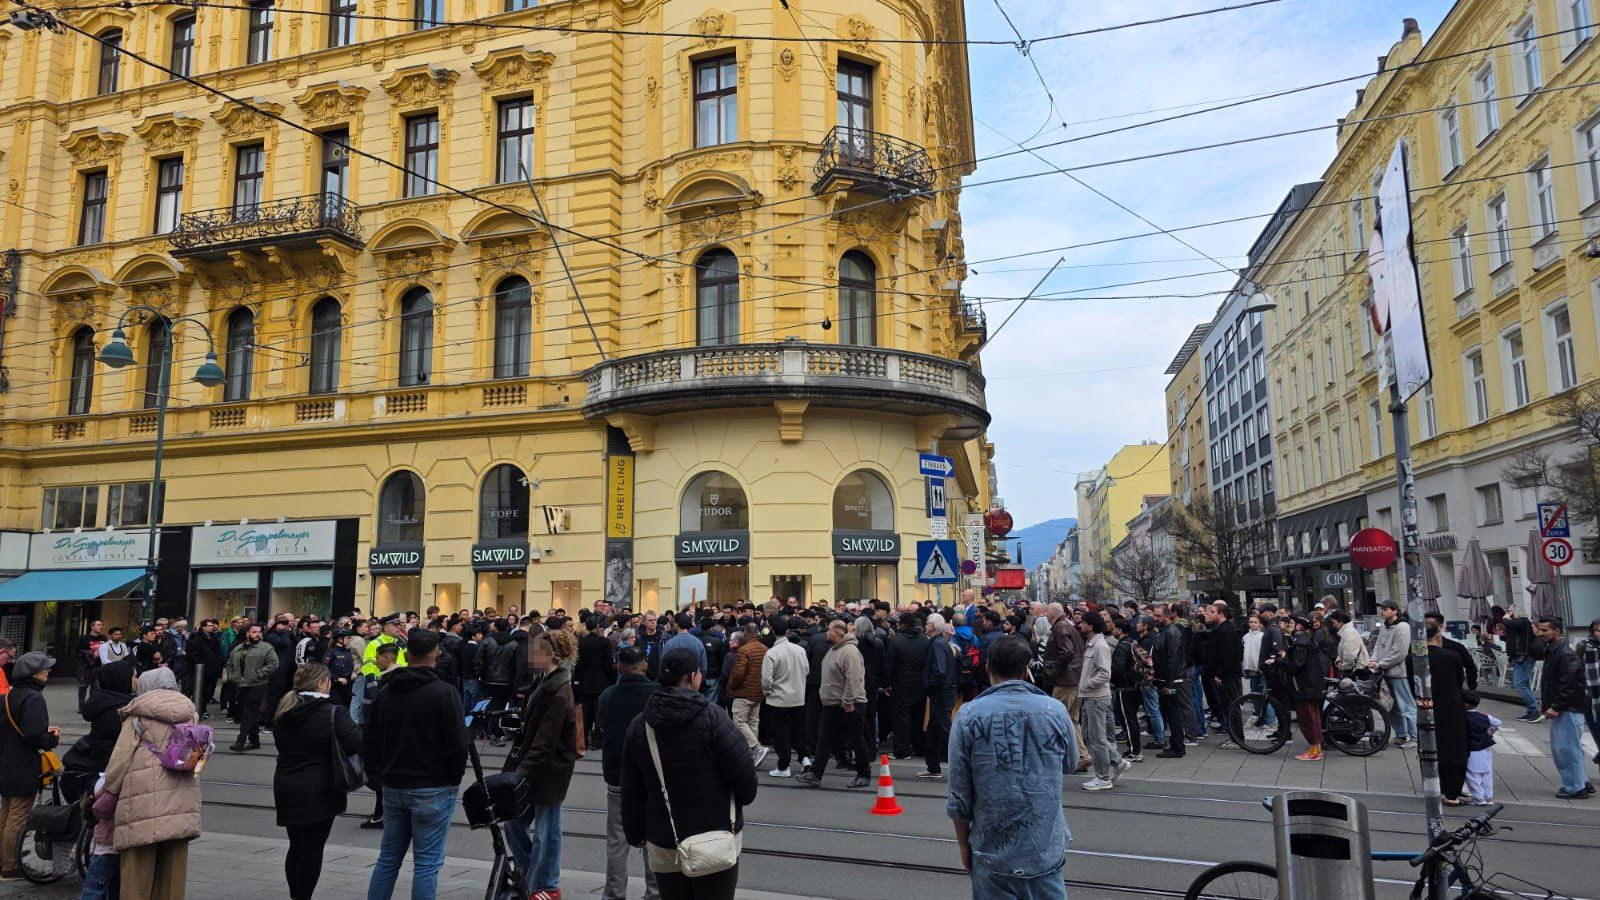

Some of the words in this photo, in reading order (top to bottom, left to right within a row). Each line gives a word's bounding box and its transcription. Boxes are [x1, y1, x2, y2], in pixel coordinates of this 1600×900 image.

[616, 458, 625, 519] BREITLING
[697, 507, 732, 516] TUDOR
[1549, 544, 1566, 560] 30
